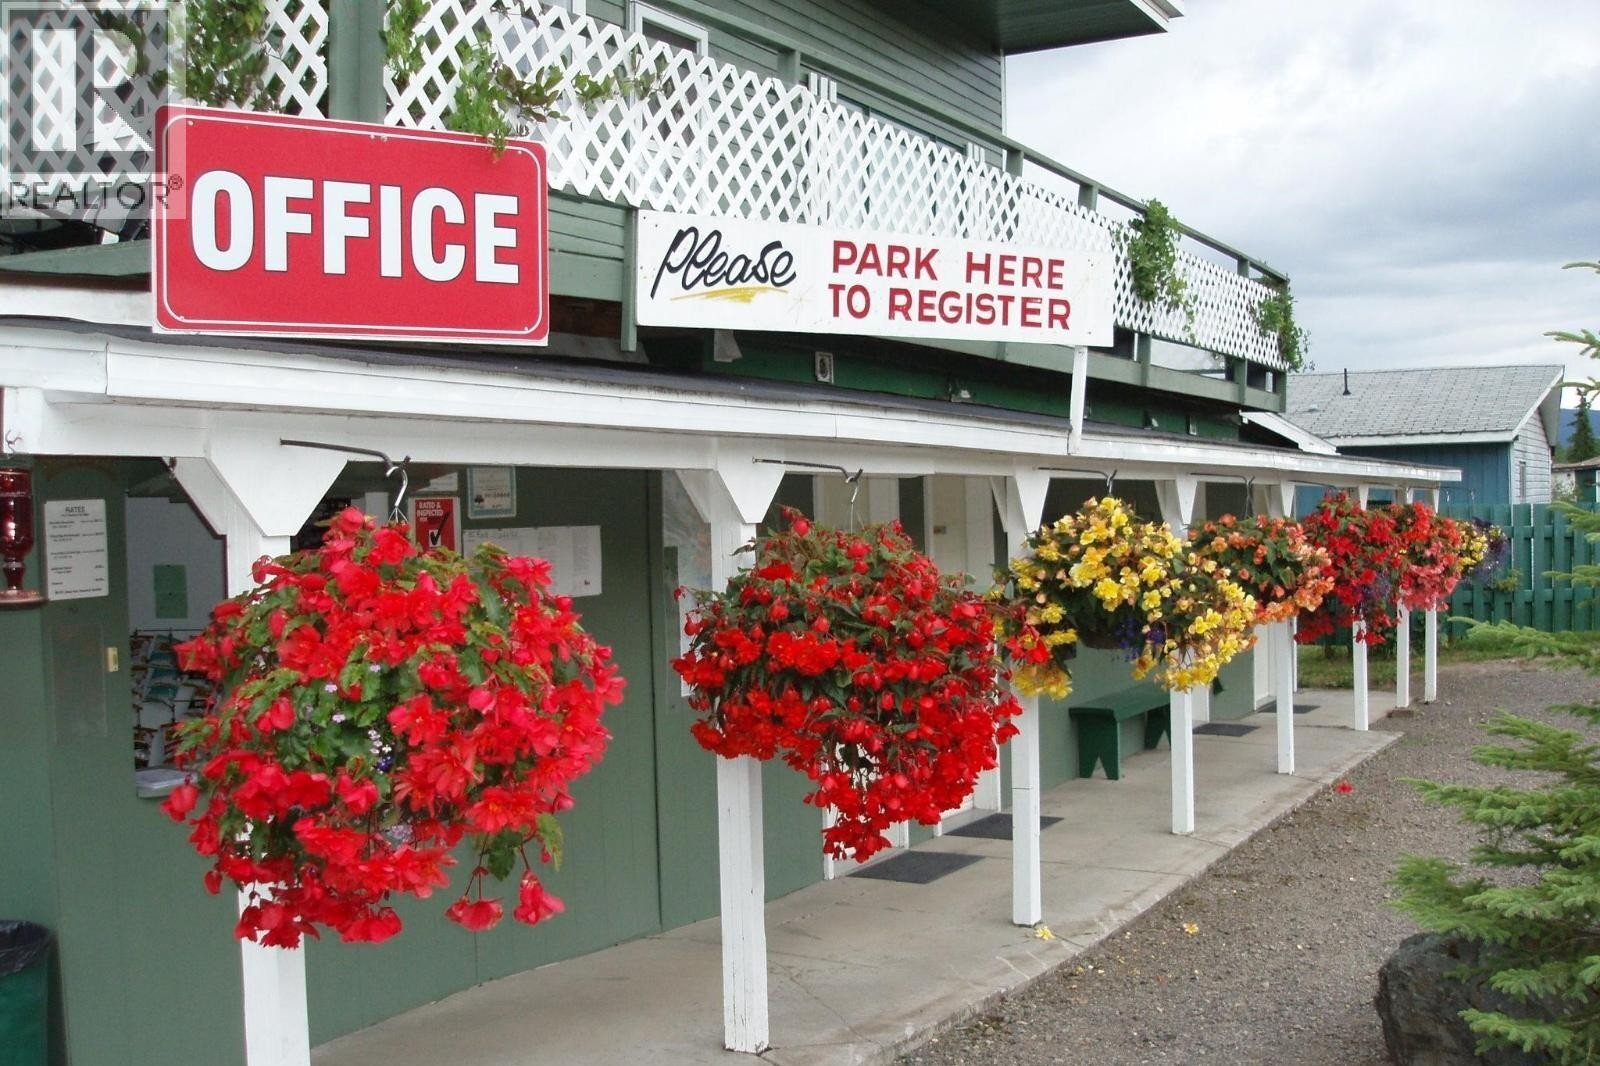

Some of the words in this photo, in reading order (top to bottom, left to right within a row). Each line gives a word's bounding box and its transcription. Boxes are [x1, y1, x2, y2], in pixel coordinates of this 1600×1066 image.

[190, 169, 520, 285] OFFICE
[649, 226, 797, 300] Please
[832, 239, 940, 281] PARK
[965, 251, 1065, 290] HERE
[828, 282, 871, 319] TO
[888, 289, 1072, 330] REGISTER
